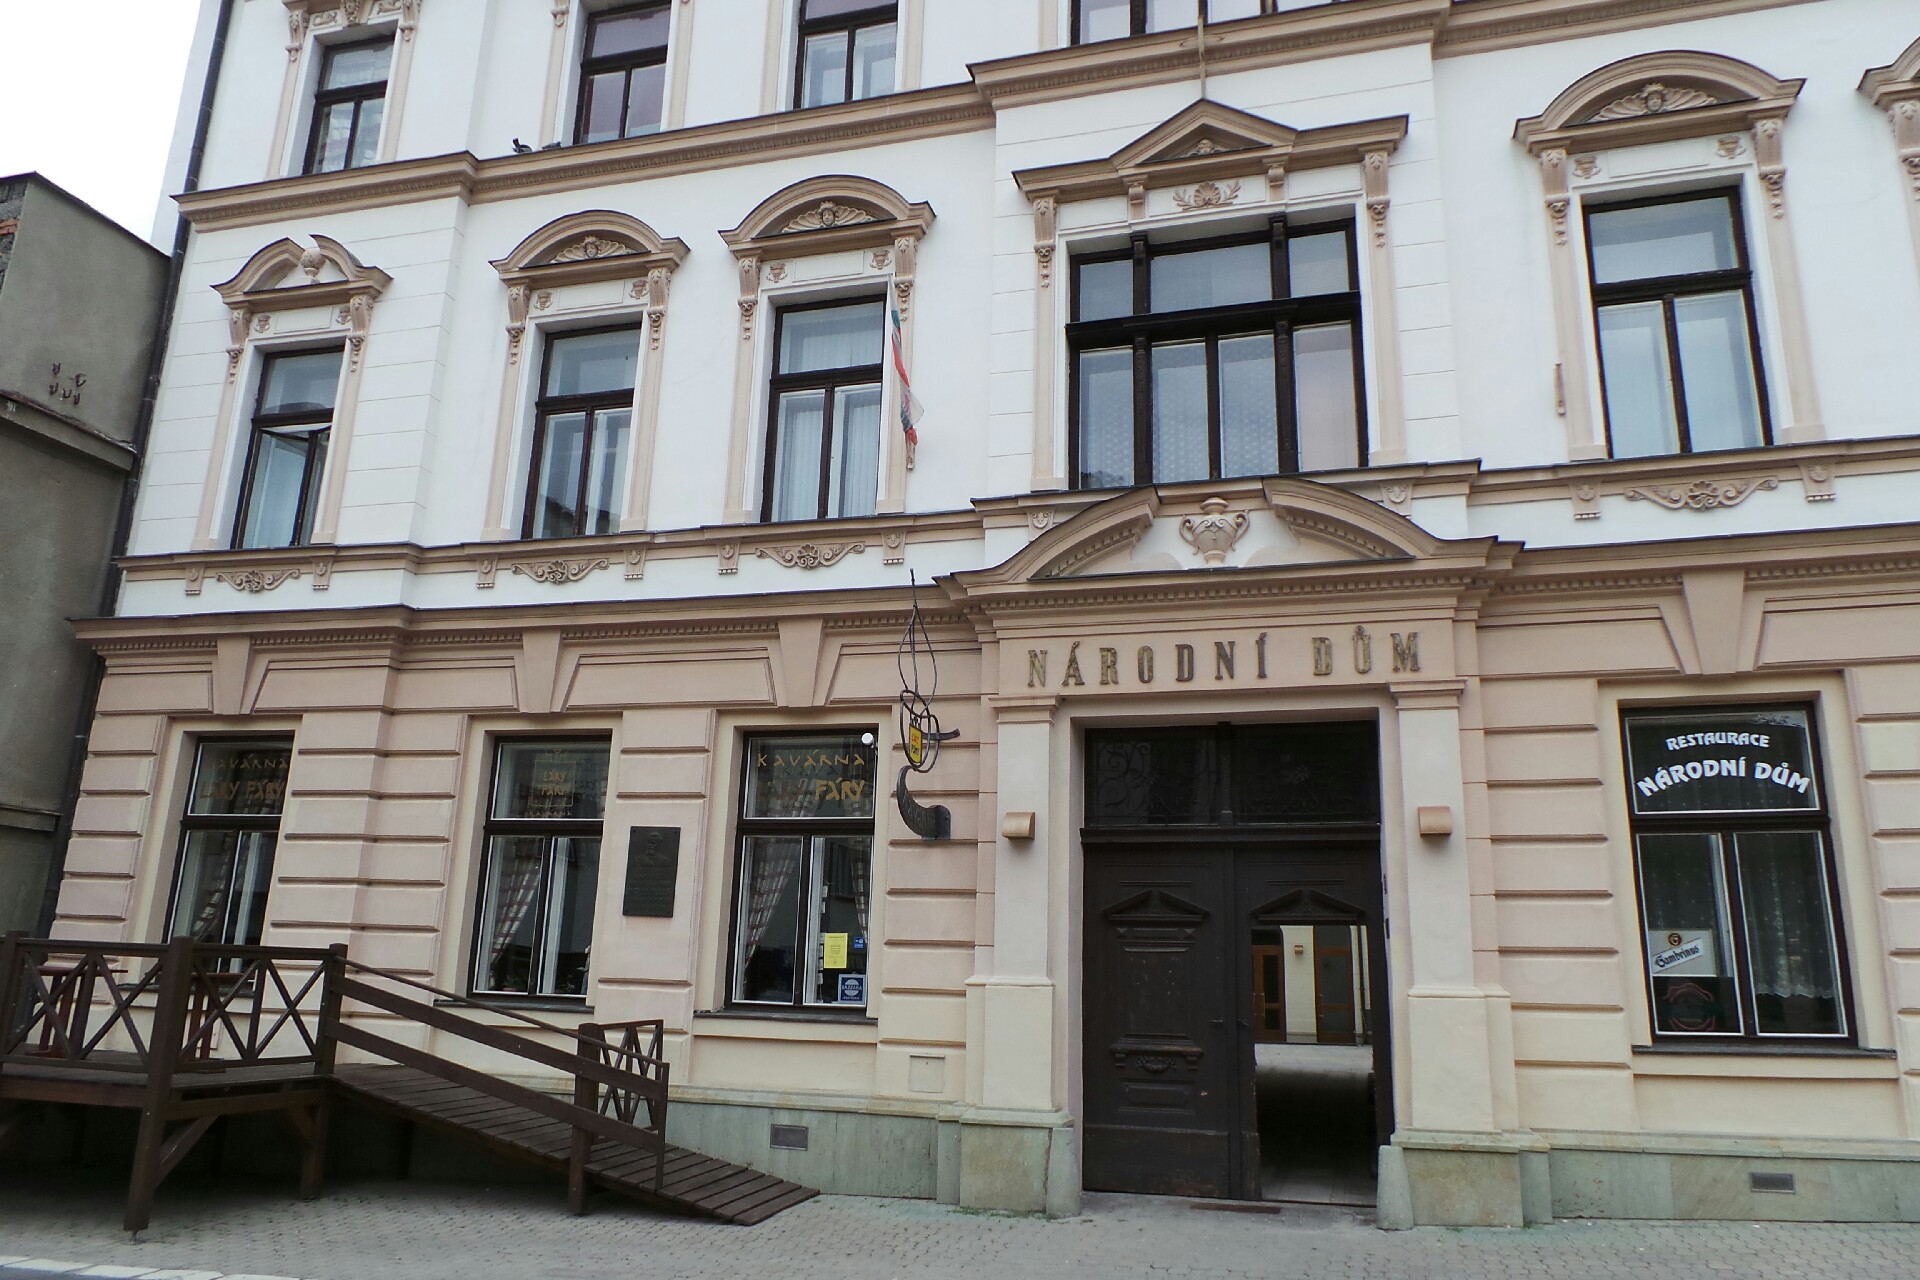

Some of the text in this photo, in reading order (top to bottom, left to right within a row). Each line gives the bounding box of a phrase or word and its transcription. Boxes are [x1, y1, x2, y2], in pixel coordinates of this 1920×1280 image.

[1027, 625, 1421, 687] NÁRODNÍ DŮM
[1665, 731, 1771, 751] RESTAURACE
[757, 748, 865, 767] KAVÁRNA
[1636, 756, 1811, 797] NÁRODNÍ DŮM
[815, 777, 865, 801] FÁRY
[1655, 945, 1700, 968] Gambrinus
